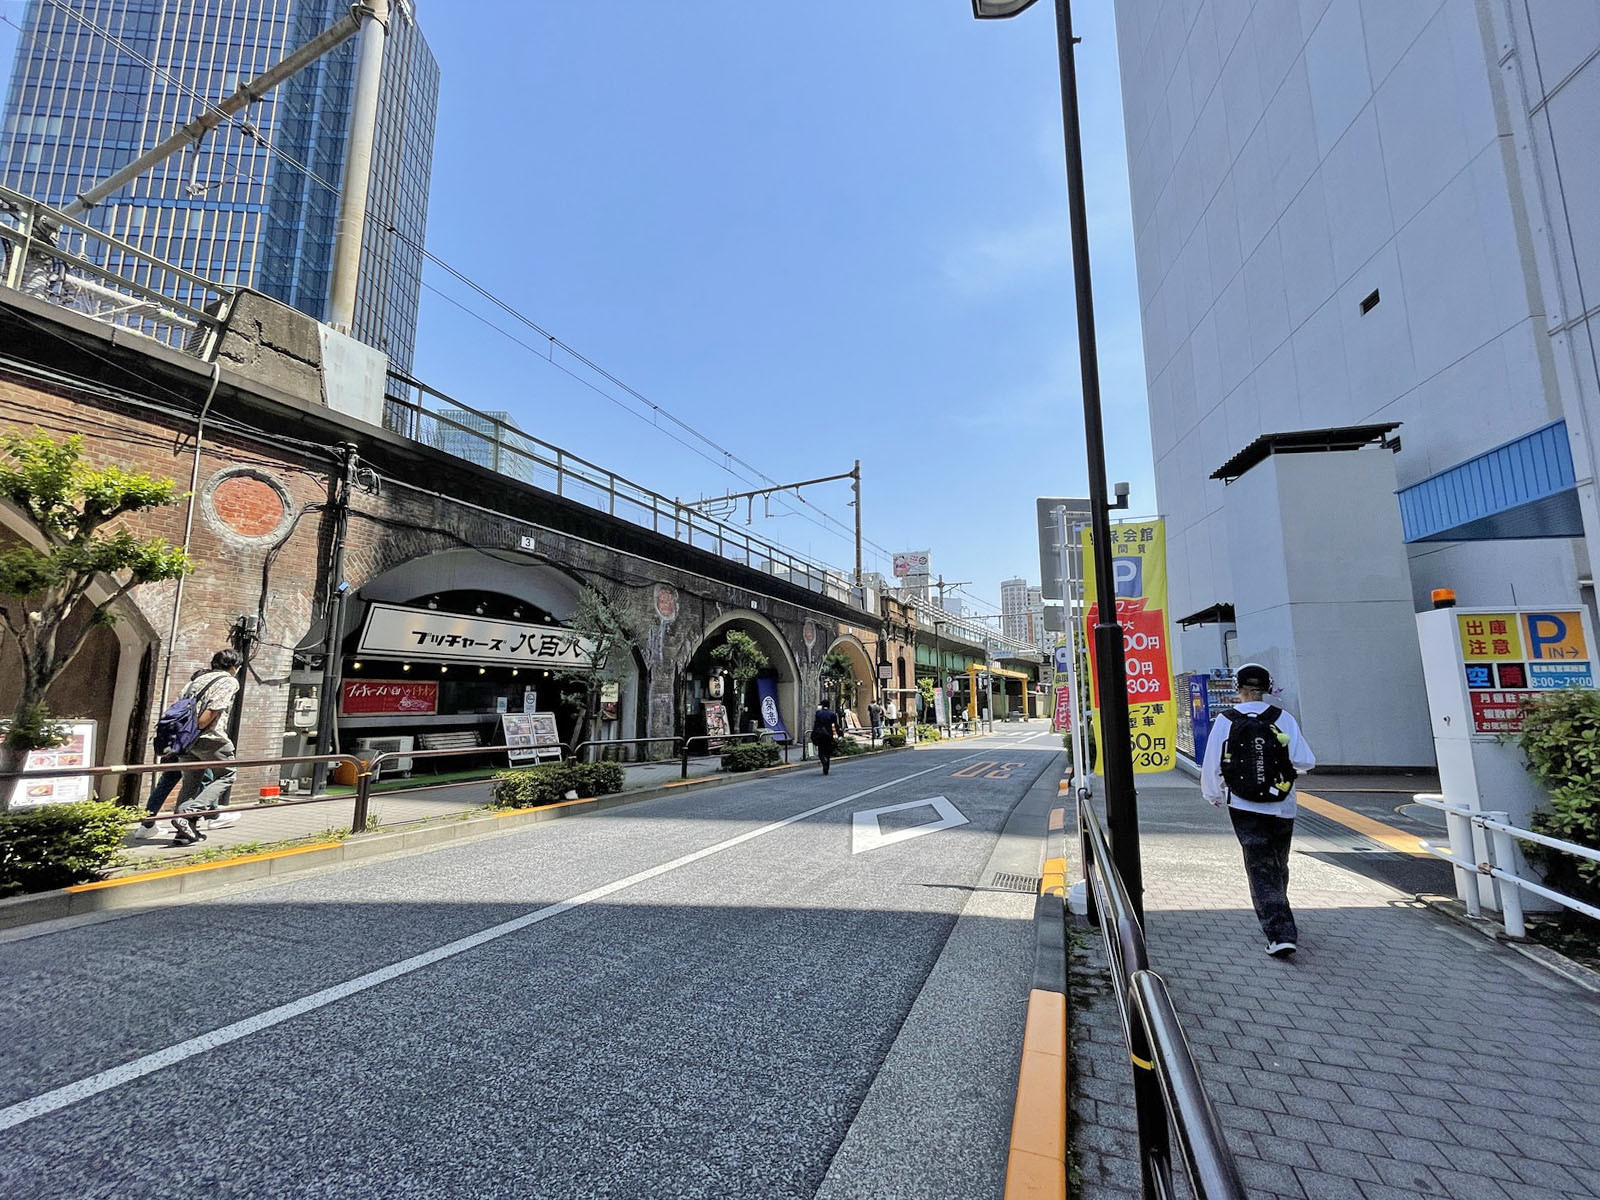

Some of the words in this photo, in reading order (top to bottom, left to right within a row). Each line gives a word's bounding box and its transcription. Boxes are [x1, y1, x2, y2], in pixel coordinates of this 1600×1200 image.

[525, 537, 531, 547] 3
[1112, 560, 1137, 594] P
[1466, 619, 1508, 636] 出庫
[411, 631, 507, 651] ブッチャーズ
[1527, 614, 1567, 659] P
[1469, 639, 1511, 656] 注意
[1548, 647, 1564, 659] IN
[1466, 666, 1491, 687] 空
[1127, 678, 1160, 694] 30分
